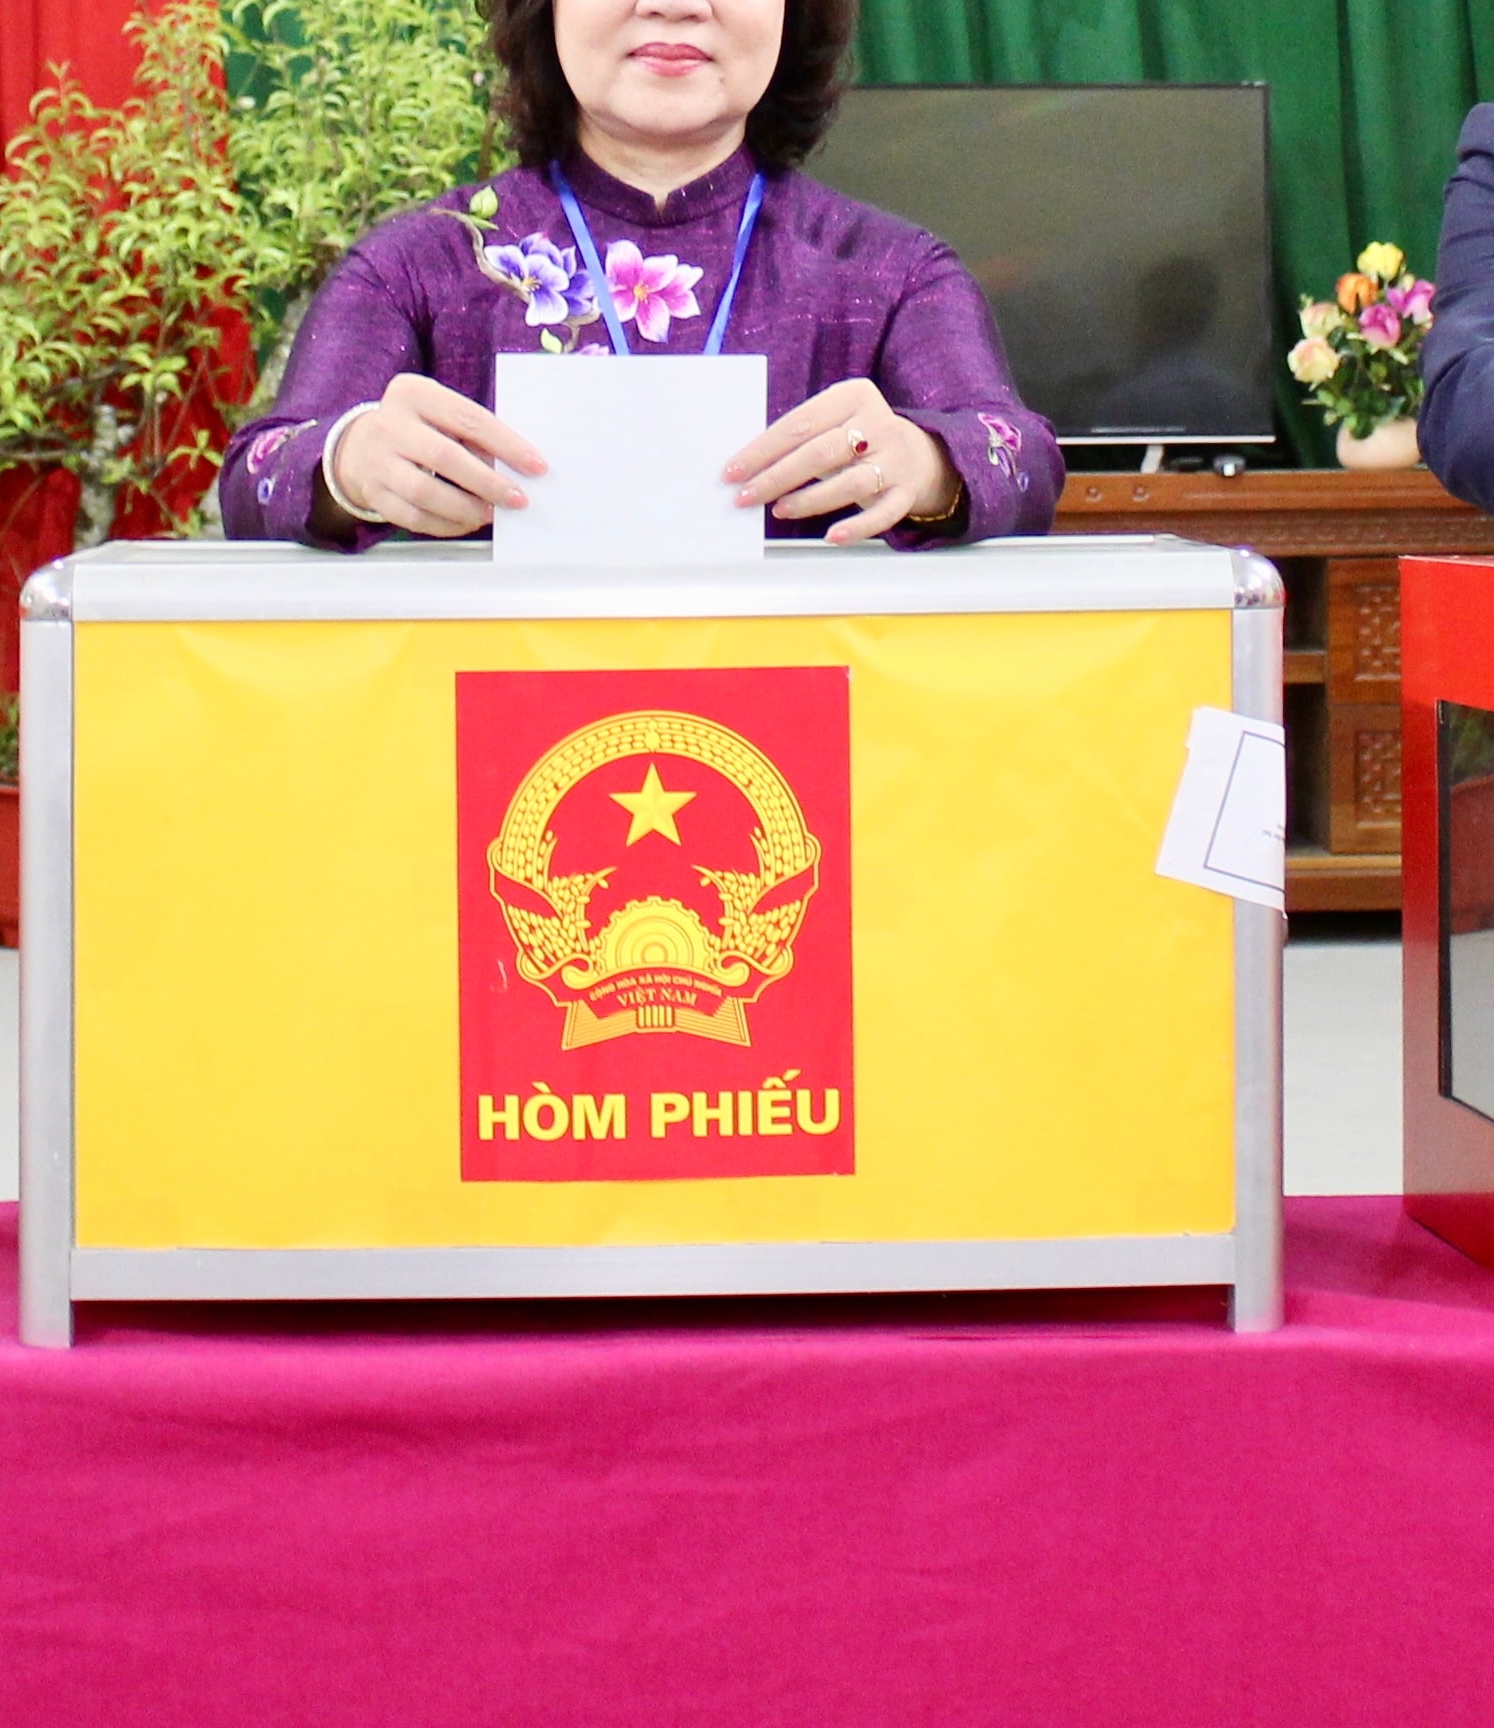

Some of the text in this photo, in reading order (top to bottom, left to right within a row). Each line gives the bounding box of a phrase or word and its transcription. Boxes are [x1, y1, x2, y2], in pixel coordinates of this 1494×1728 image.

[616, 985, 697, 1006] VIỆT NAM
[478, 1069, 840, 1141] HÒM PHIẾU
